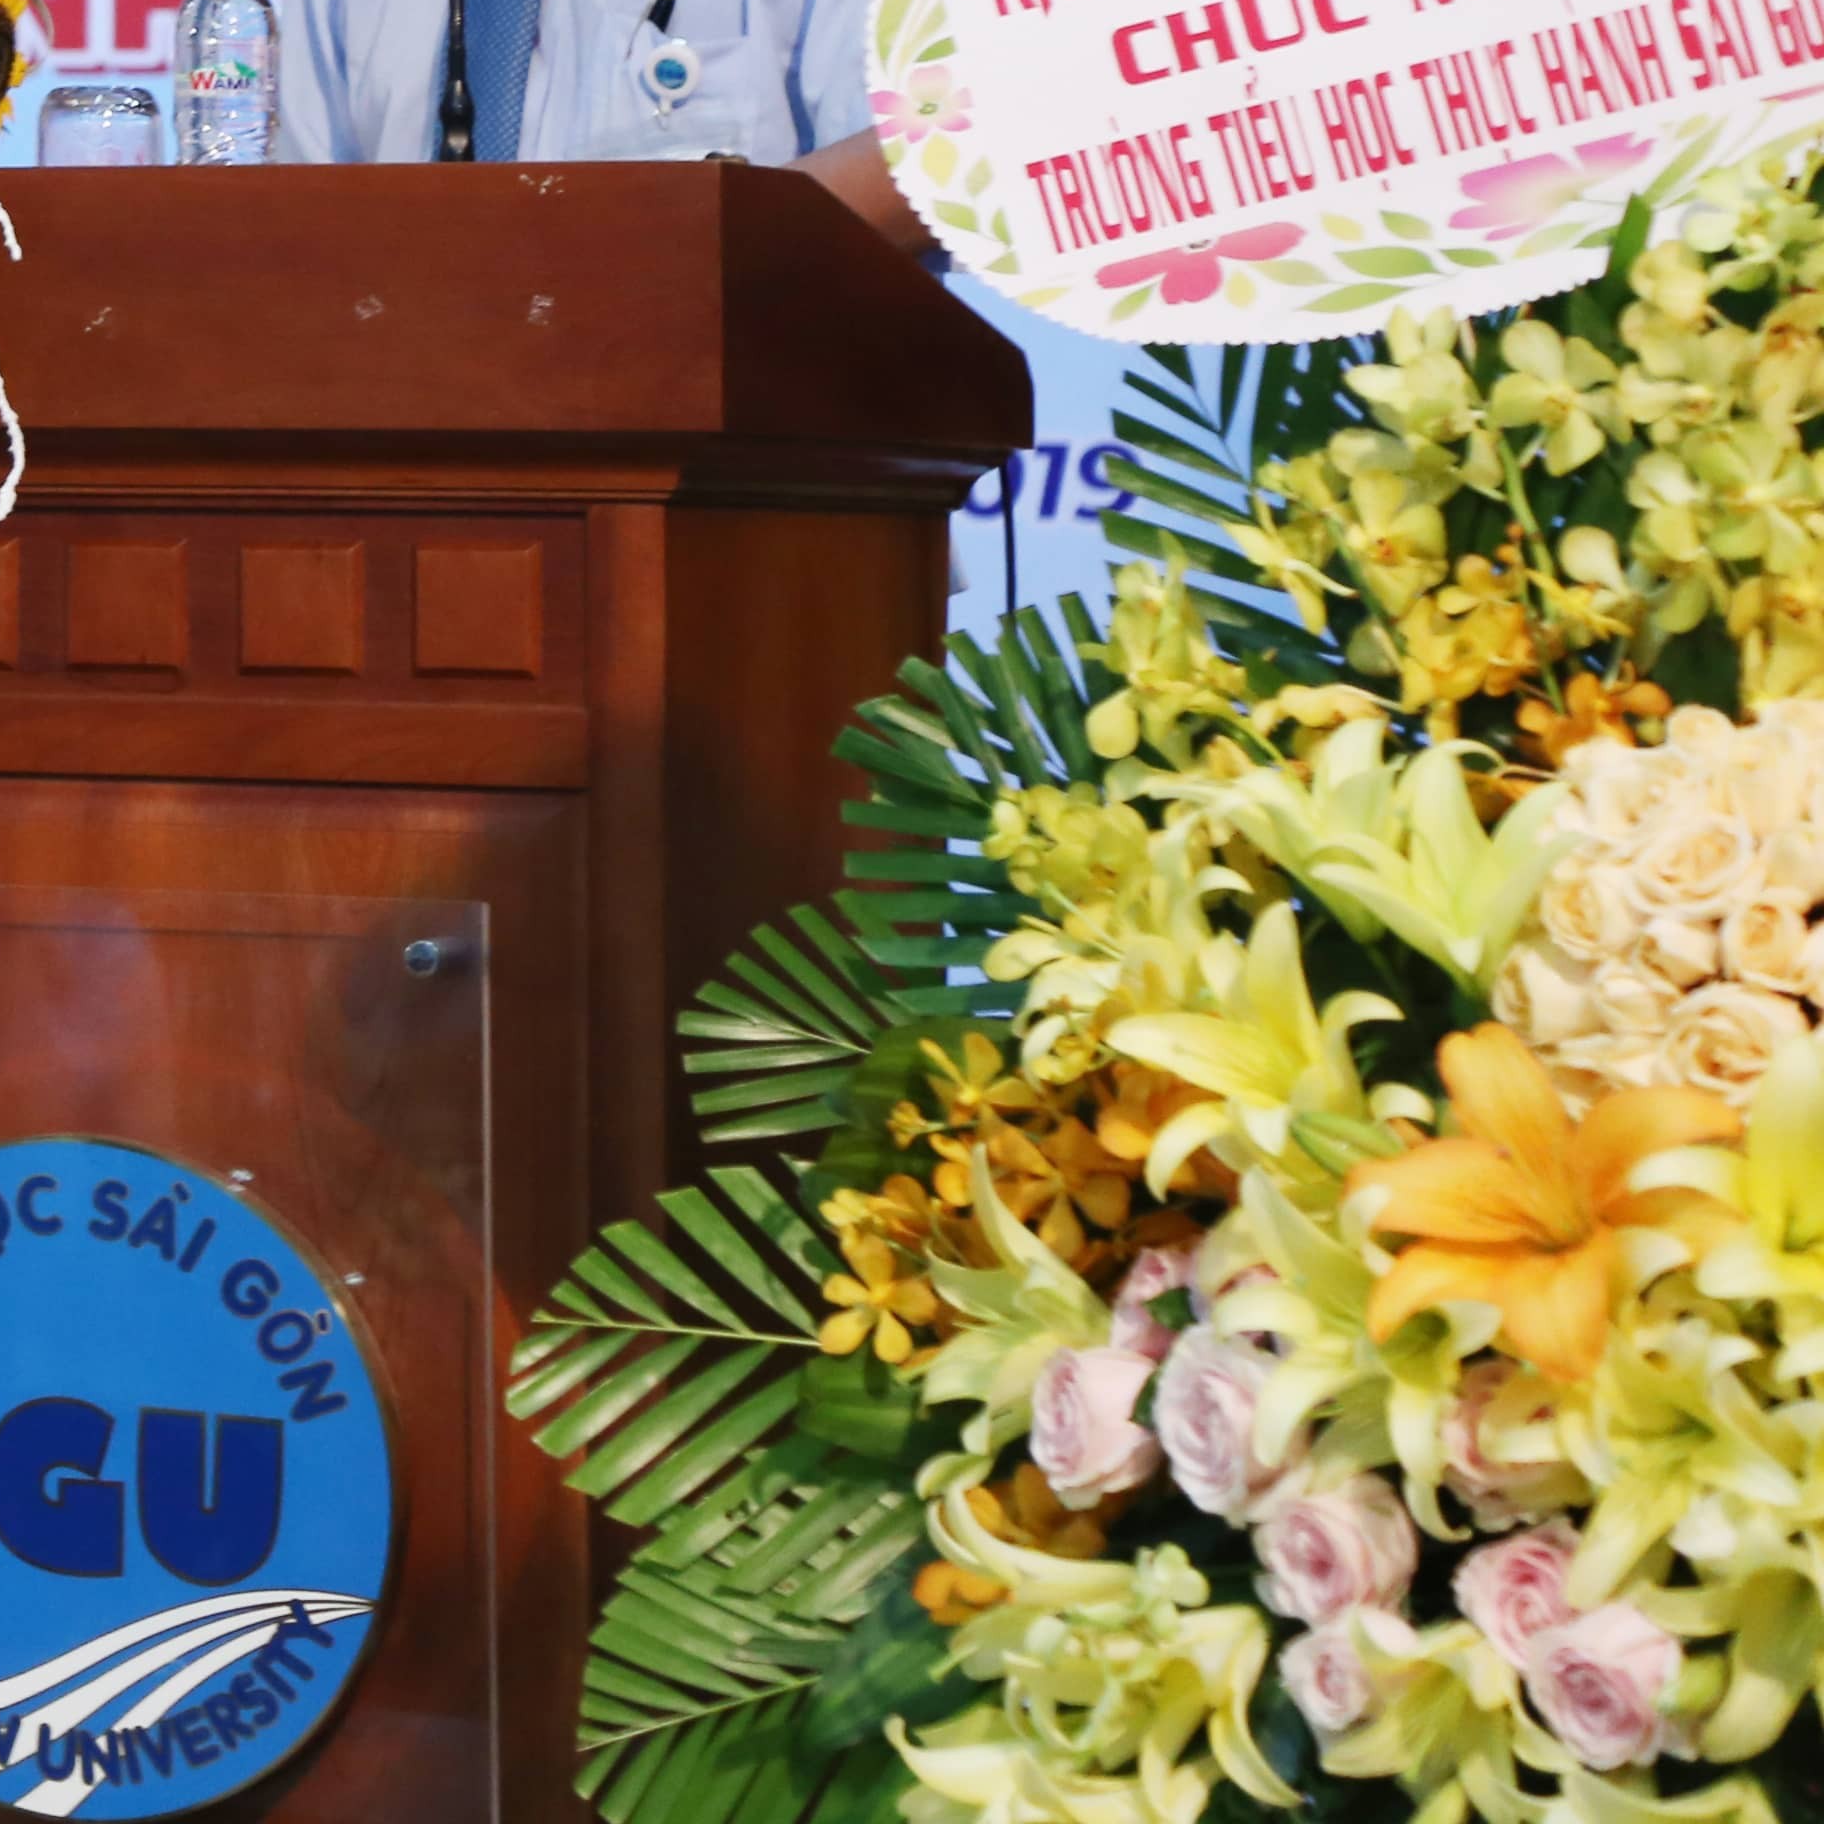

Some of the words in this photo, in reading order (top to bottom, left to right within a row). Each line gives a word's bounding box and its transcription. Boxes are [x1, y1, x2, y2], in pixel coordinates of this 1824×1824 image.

[1024, 116, 1216, 255] TRƯỜNG
[1207, 66, 1317, 208] TIỂU
[1314, 71, 1415, 192] HỌC
[1408, 39, 1538, 164] THỰC
[1531, 0, 1677, 127] HÀNH
[87, 1181, 217, 1274] SÀI
[219, 1257, 348, 1425] GÒN
[34, 1597, 336, 1787] UNIVERSITY
